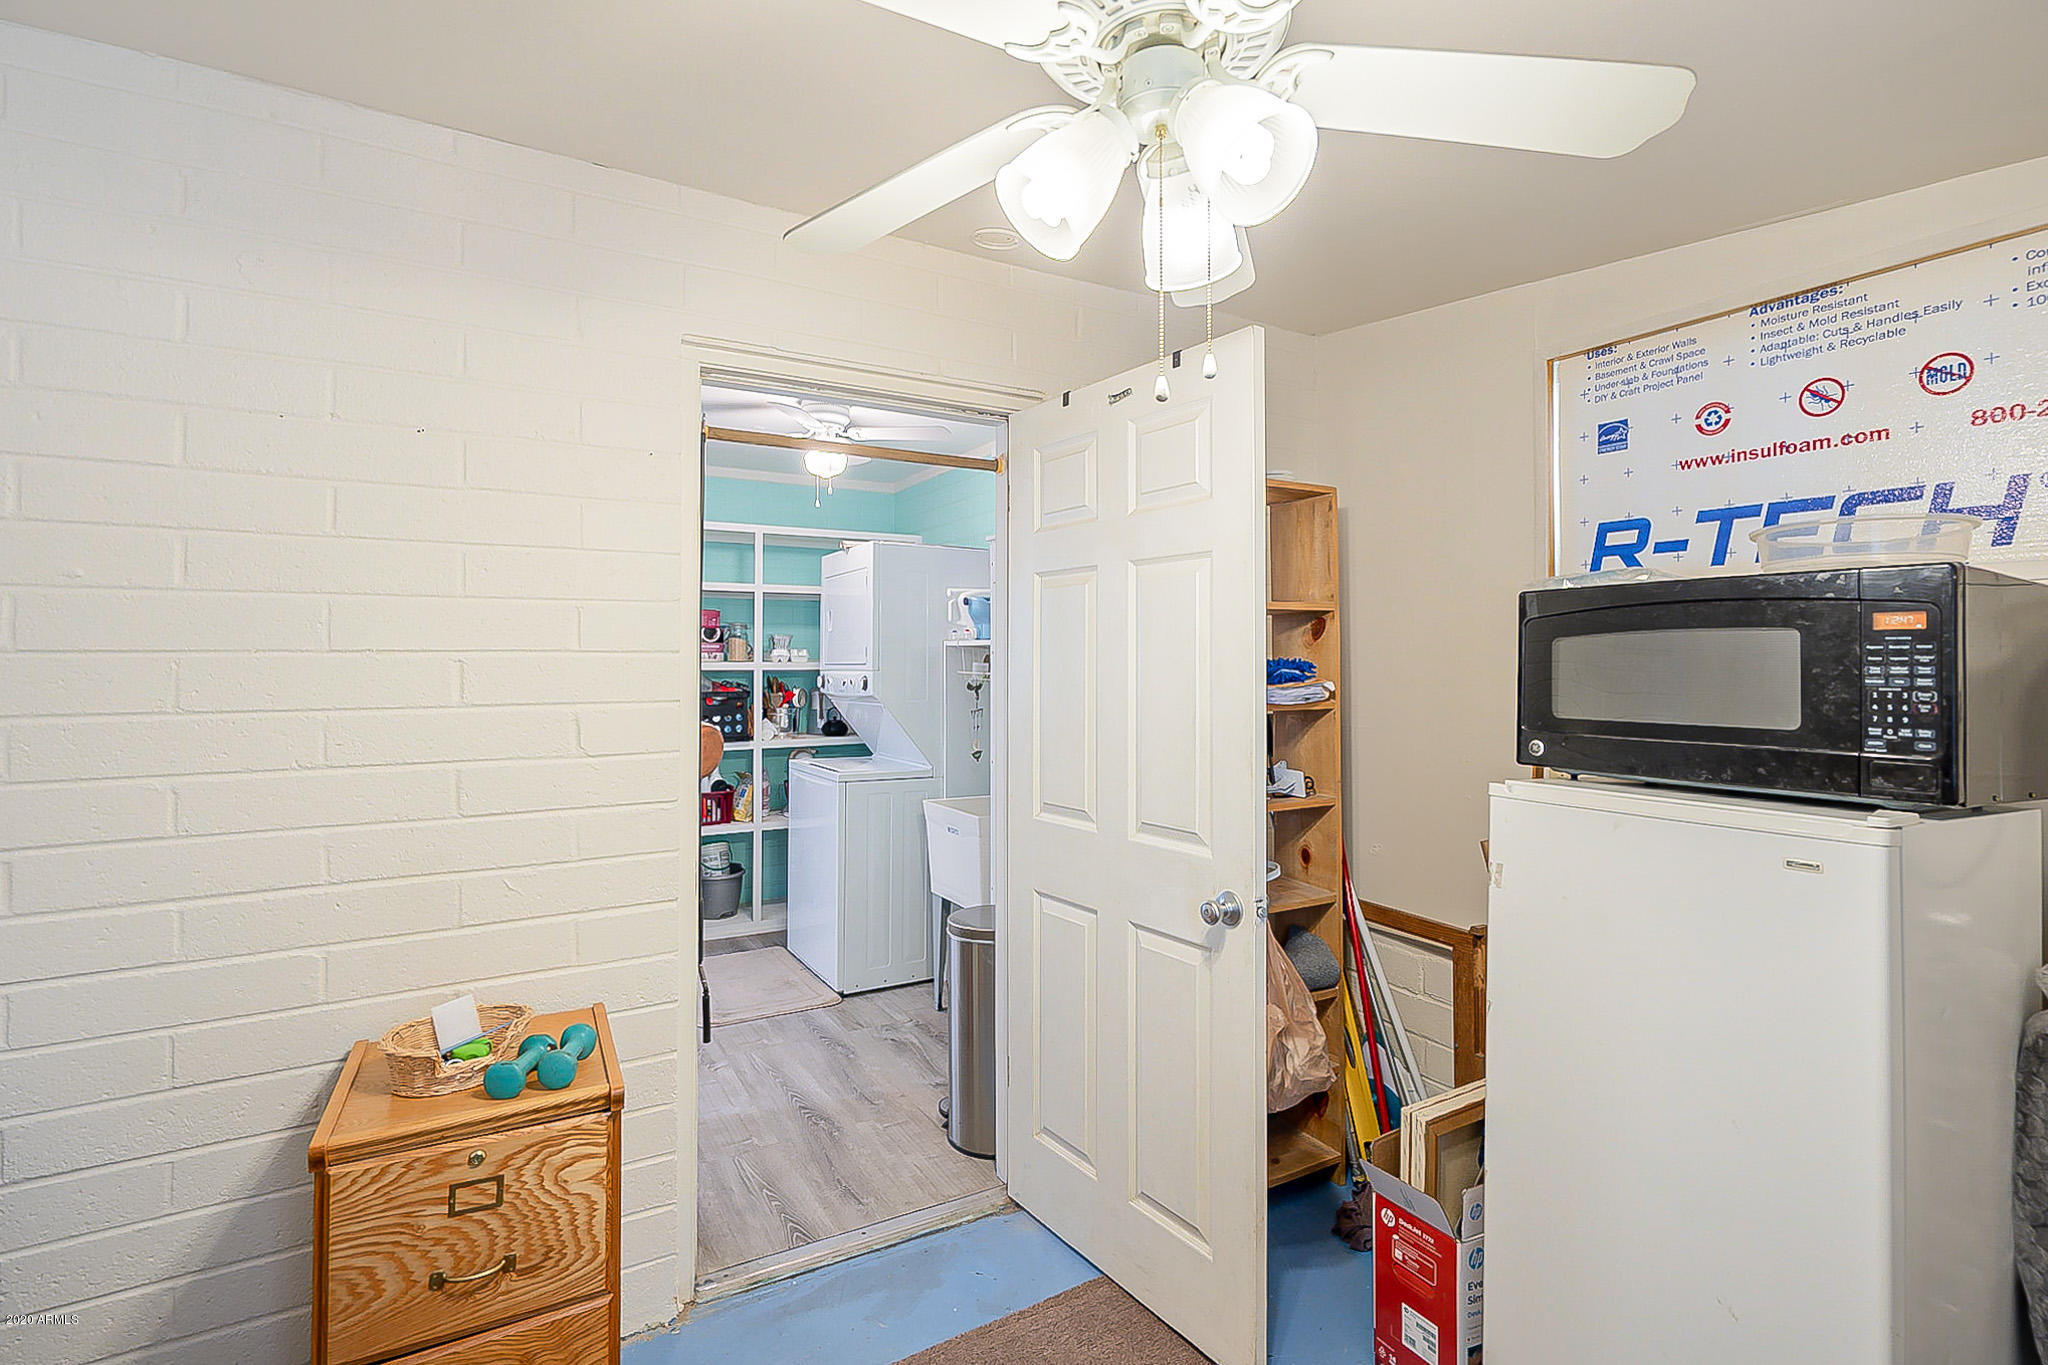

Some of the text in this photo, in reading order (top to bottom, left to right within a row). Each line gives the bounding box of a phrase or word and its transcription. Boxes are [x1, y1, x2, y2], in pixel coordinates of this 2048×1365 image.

[1749, 286, 1843, 317] Advantages:
[1760, 293, 1868, 327] Moisture Resistant
[2027, 294, 2048, 308] 10
[1760, 299, 1900, 340] Insect & Mold Resistant
[1760, 299, 1963, 353] Adaptable: Cuts & Handles Easily
[1587, 345, 1617, 360] Uses:
[1595, 337, 1697, 369] Interior & Exterior Walls
[1760, 327, 1907, 367] Lightweight & Recyclable
[1595, 348, 1706, 380] Basement & Crawl Space
[1642, 373, 1649, 381] &
[1651, 360, 1709, 378] Foundations
[1926, 362, 1967, 385] MOLD
[1594, 372, 1703, 404] DIY & Craft Project Panel
[1679, 426, 1890, 471] www.insulfoam.com
[1381, 1207, 1396, 1227] hp
